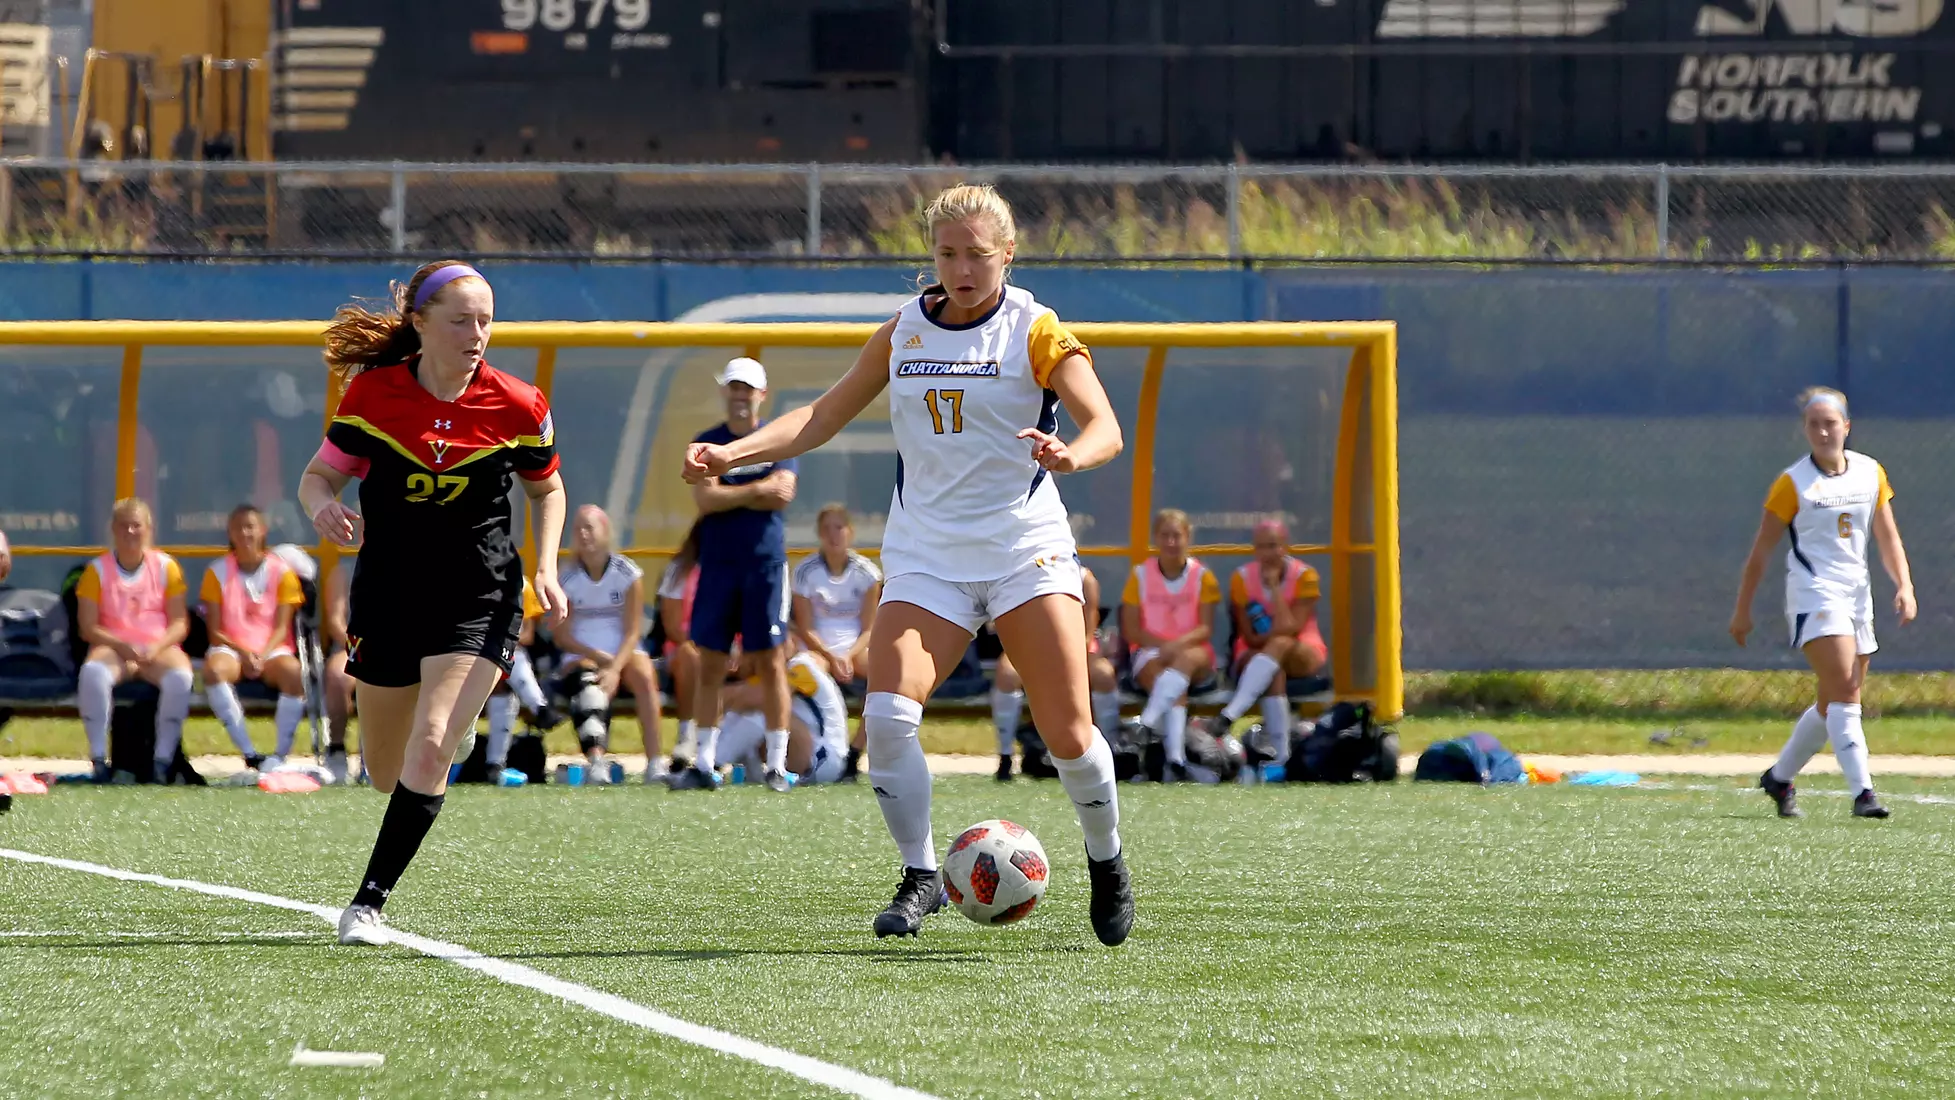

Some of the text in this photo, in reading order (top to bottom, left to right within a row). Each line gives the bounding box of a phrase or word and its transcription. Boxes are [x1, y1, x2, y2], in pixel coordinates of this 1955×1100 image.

[501, 0, 650, 31] 9879
[1679, 53, 1897, 87] NORFOLK
[1667, 88, 1921, 123] SOUTHERN
[900, 361, 998, 376] CHATTANOOGA
[923, 389, 965, 435] 17
[404, 473, 470, 506] 27
[1837, 512, 1852, 539] 6
